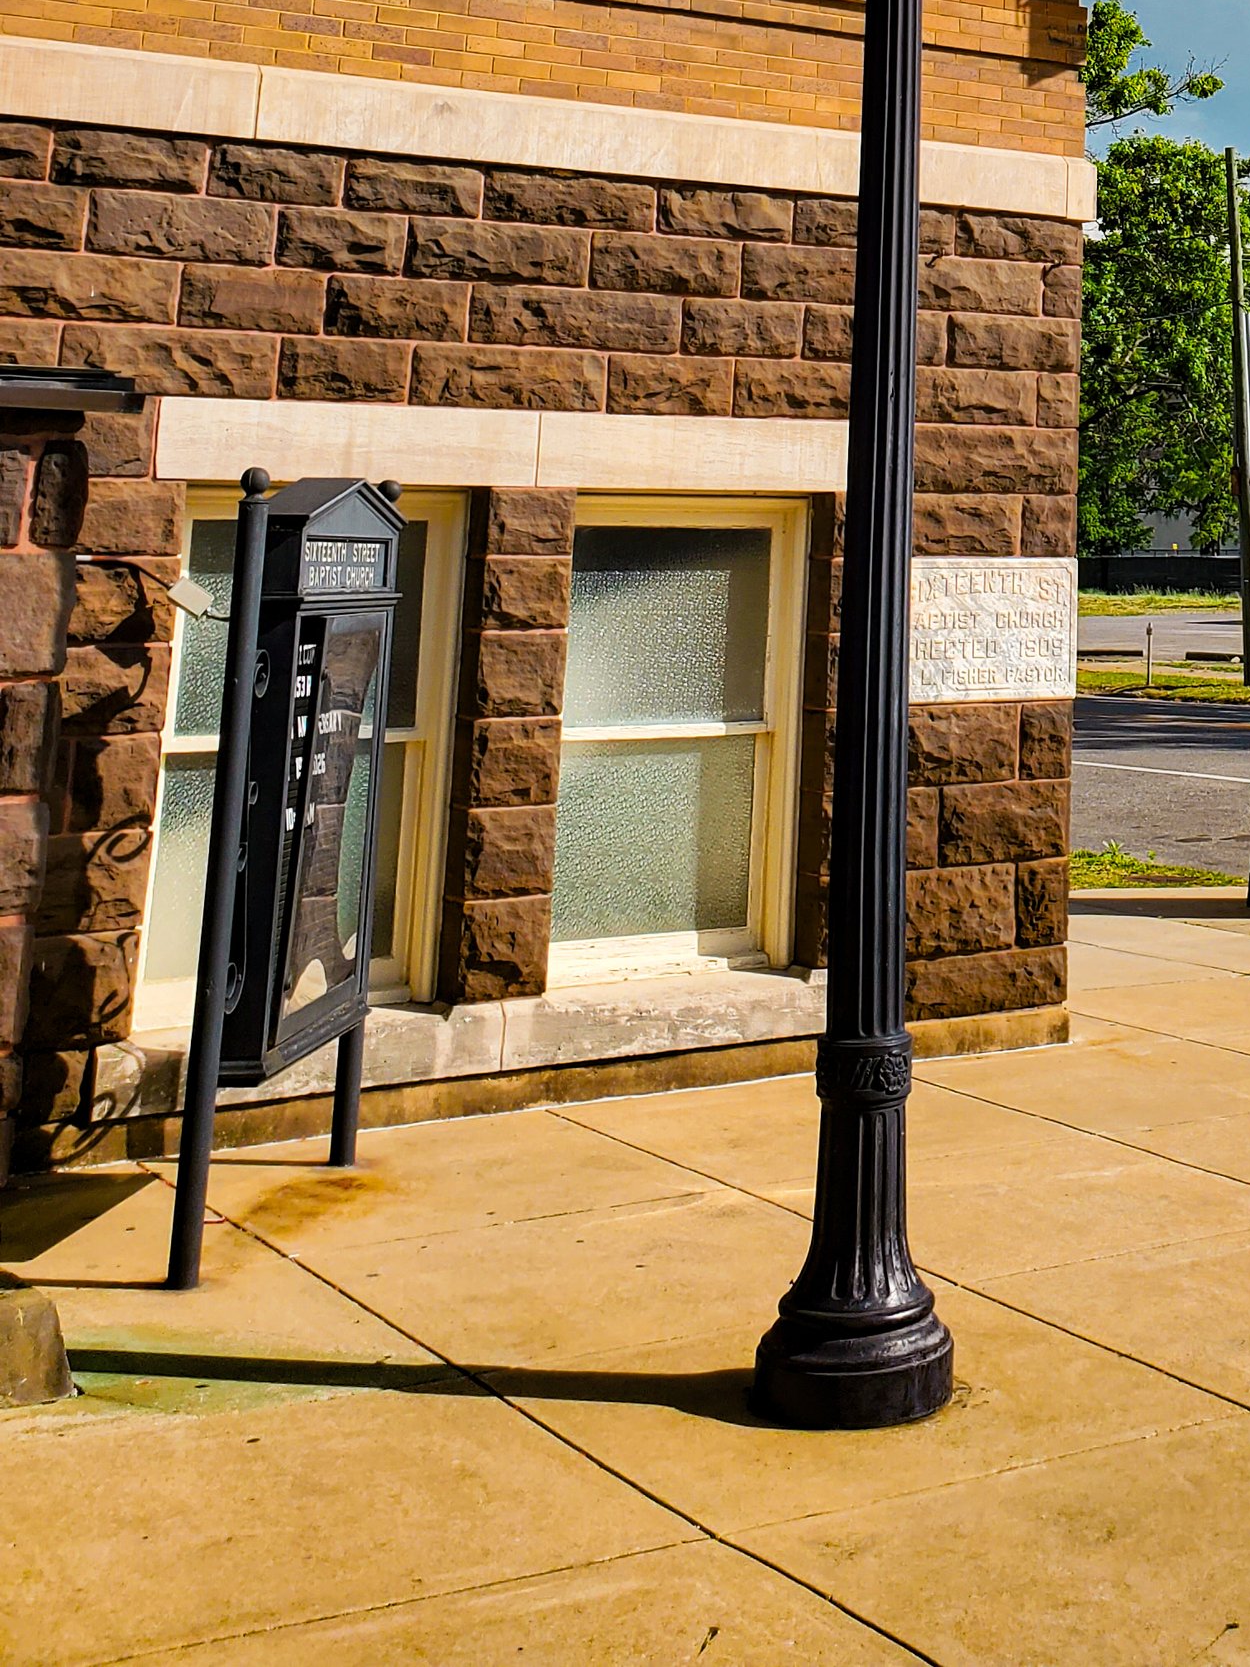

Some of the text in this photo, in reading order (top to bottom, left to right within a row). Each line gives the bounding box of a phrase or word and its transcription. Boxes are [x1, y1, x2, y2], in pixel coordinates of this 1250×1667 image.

[304, 542, 380, 563] SIXTEENTH STREET
[308, 566, 375, 588] BAPTIST CHURCH
[918, 569, 1026, 603] IXTEENTH
[914, 609, 1065, 631] APTIST CHURCH
[914, 637, 998, 661] RECTED
[941, 665, 997, 685] FISHER
